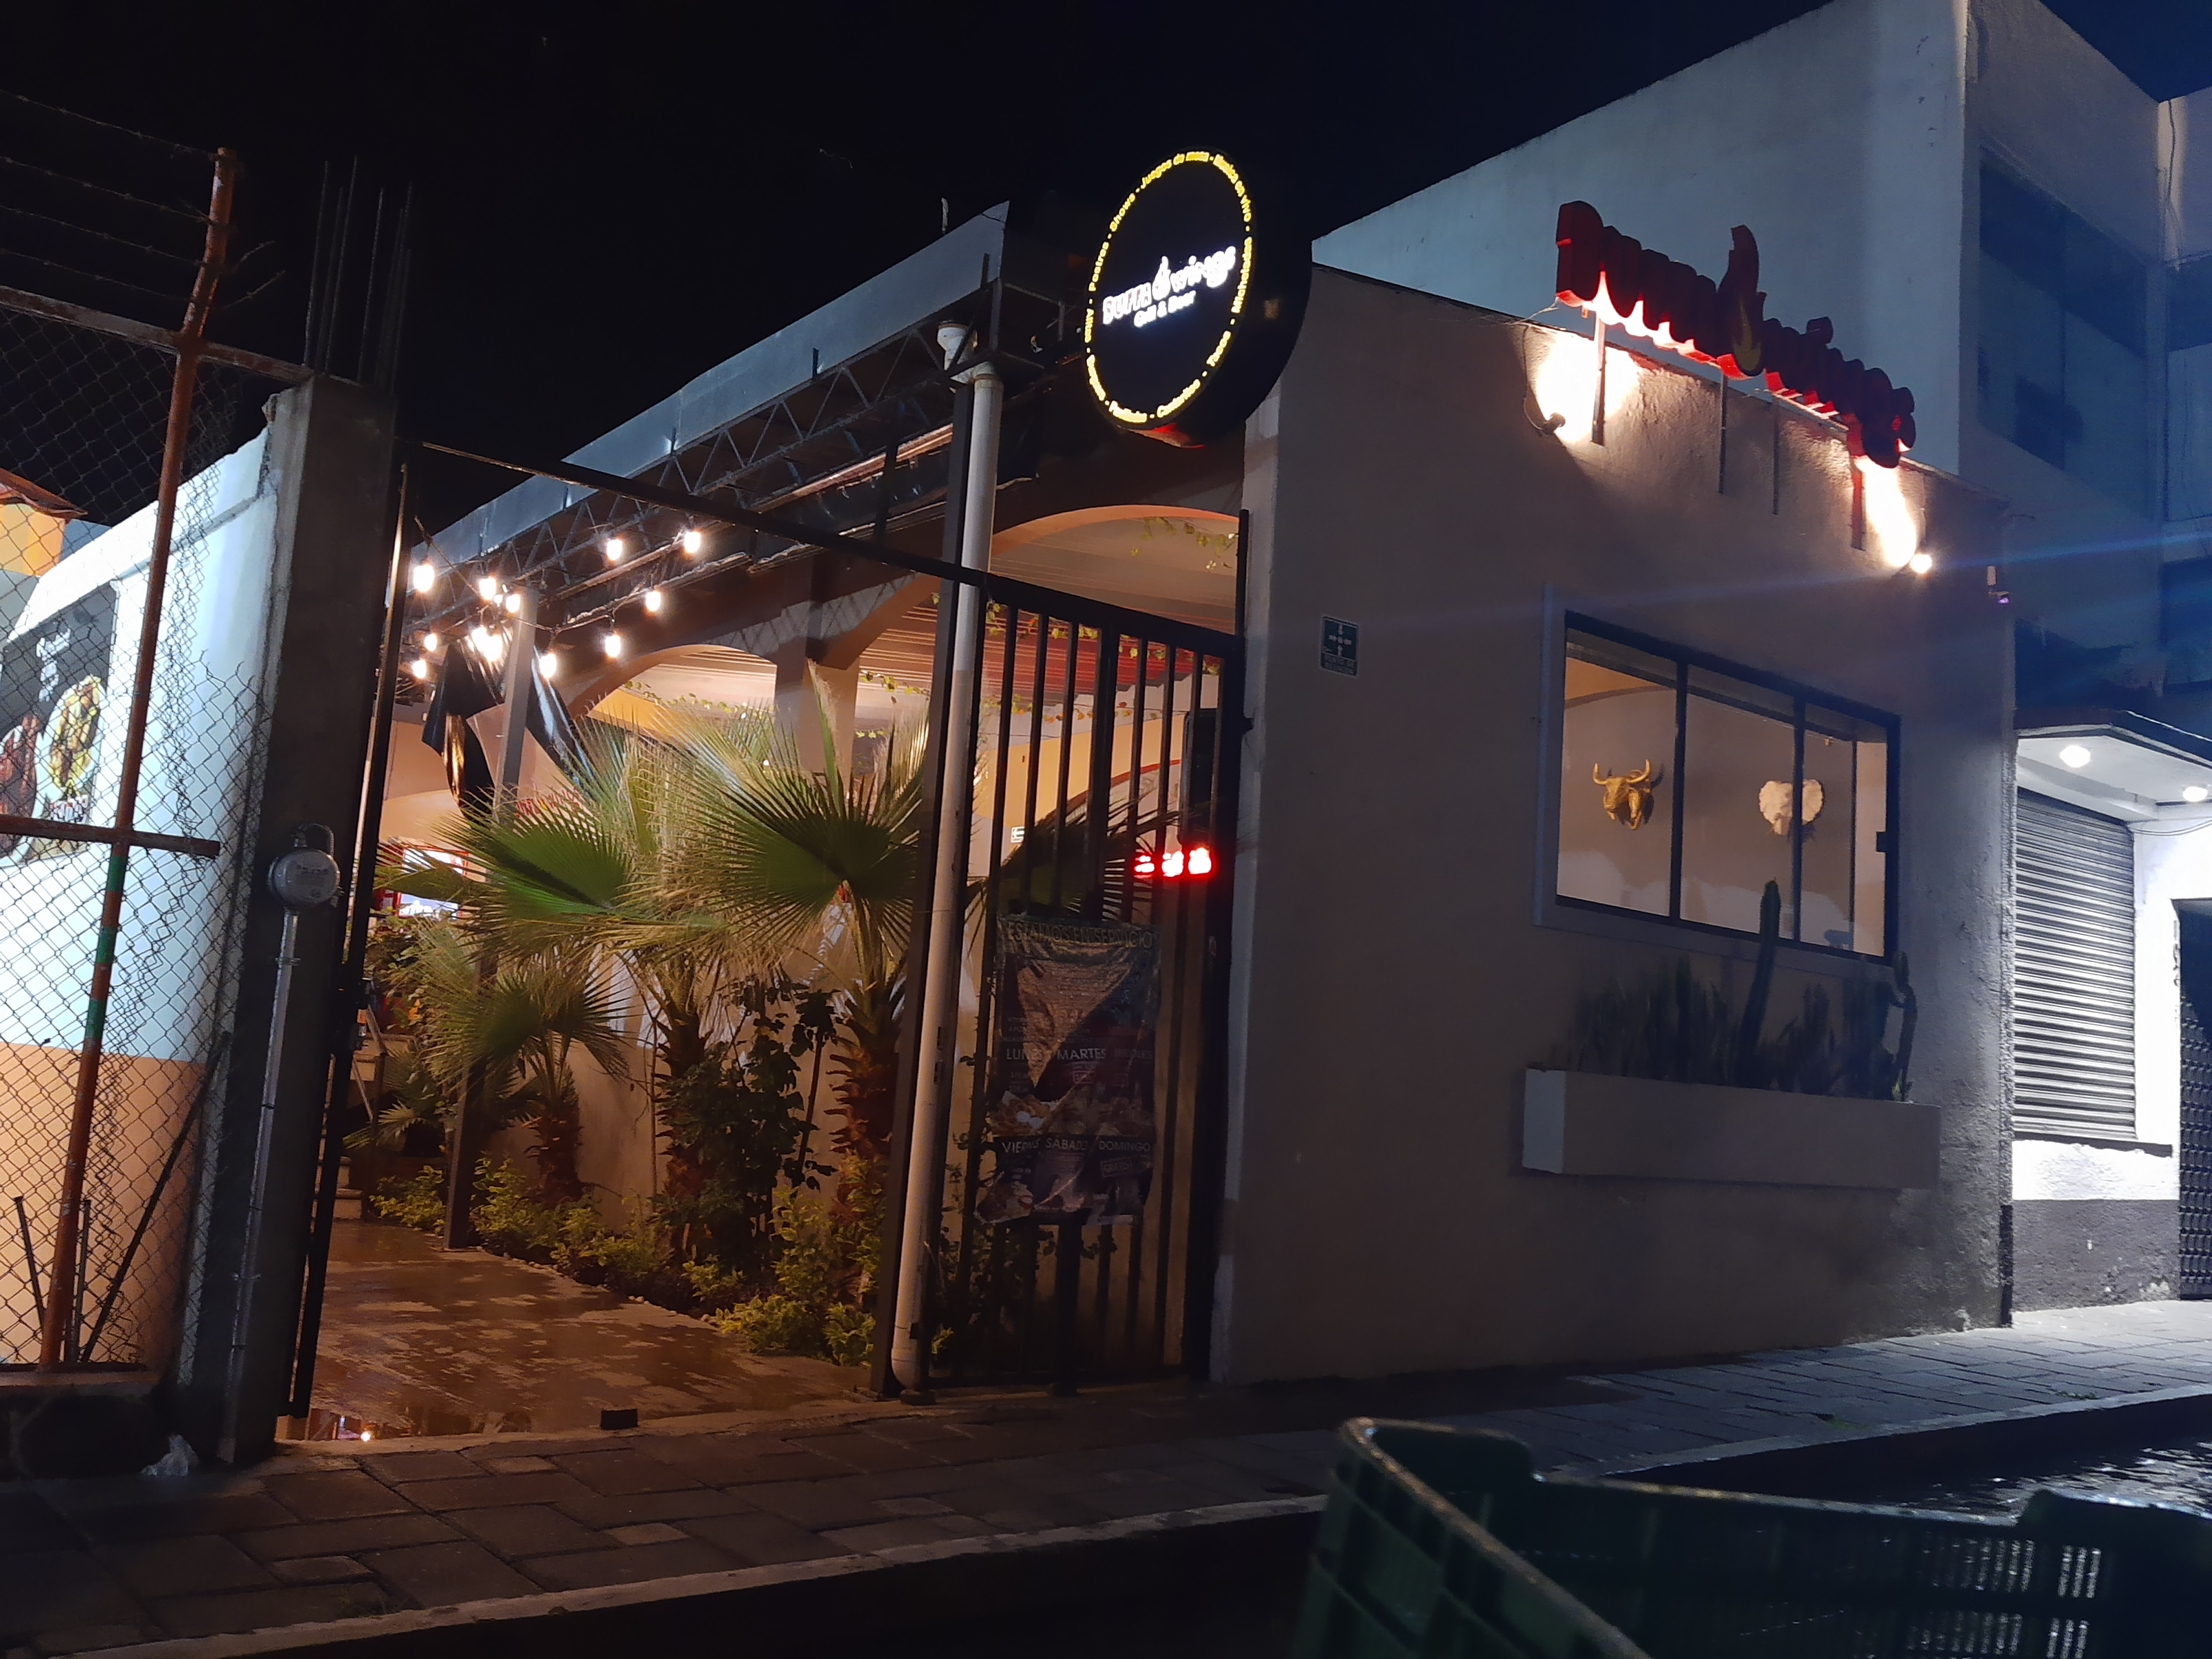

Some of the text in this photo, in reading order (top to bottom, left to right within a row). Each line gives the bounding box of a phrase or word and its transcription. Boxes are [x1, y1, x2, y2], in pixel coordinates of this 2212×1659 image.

[1109, 193, 1136, 232] Shows
[1057, 1047, 1107, 1061] MARTES
[1098, 1140, 1151, 1153] DOMINGO
